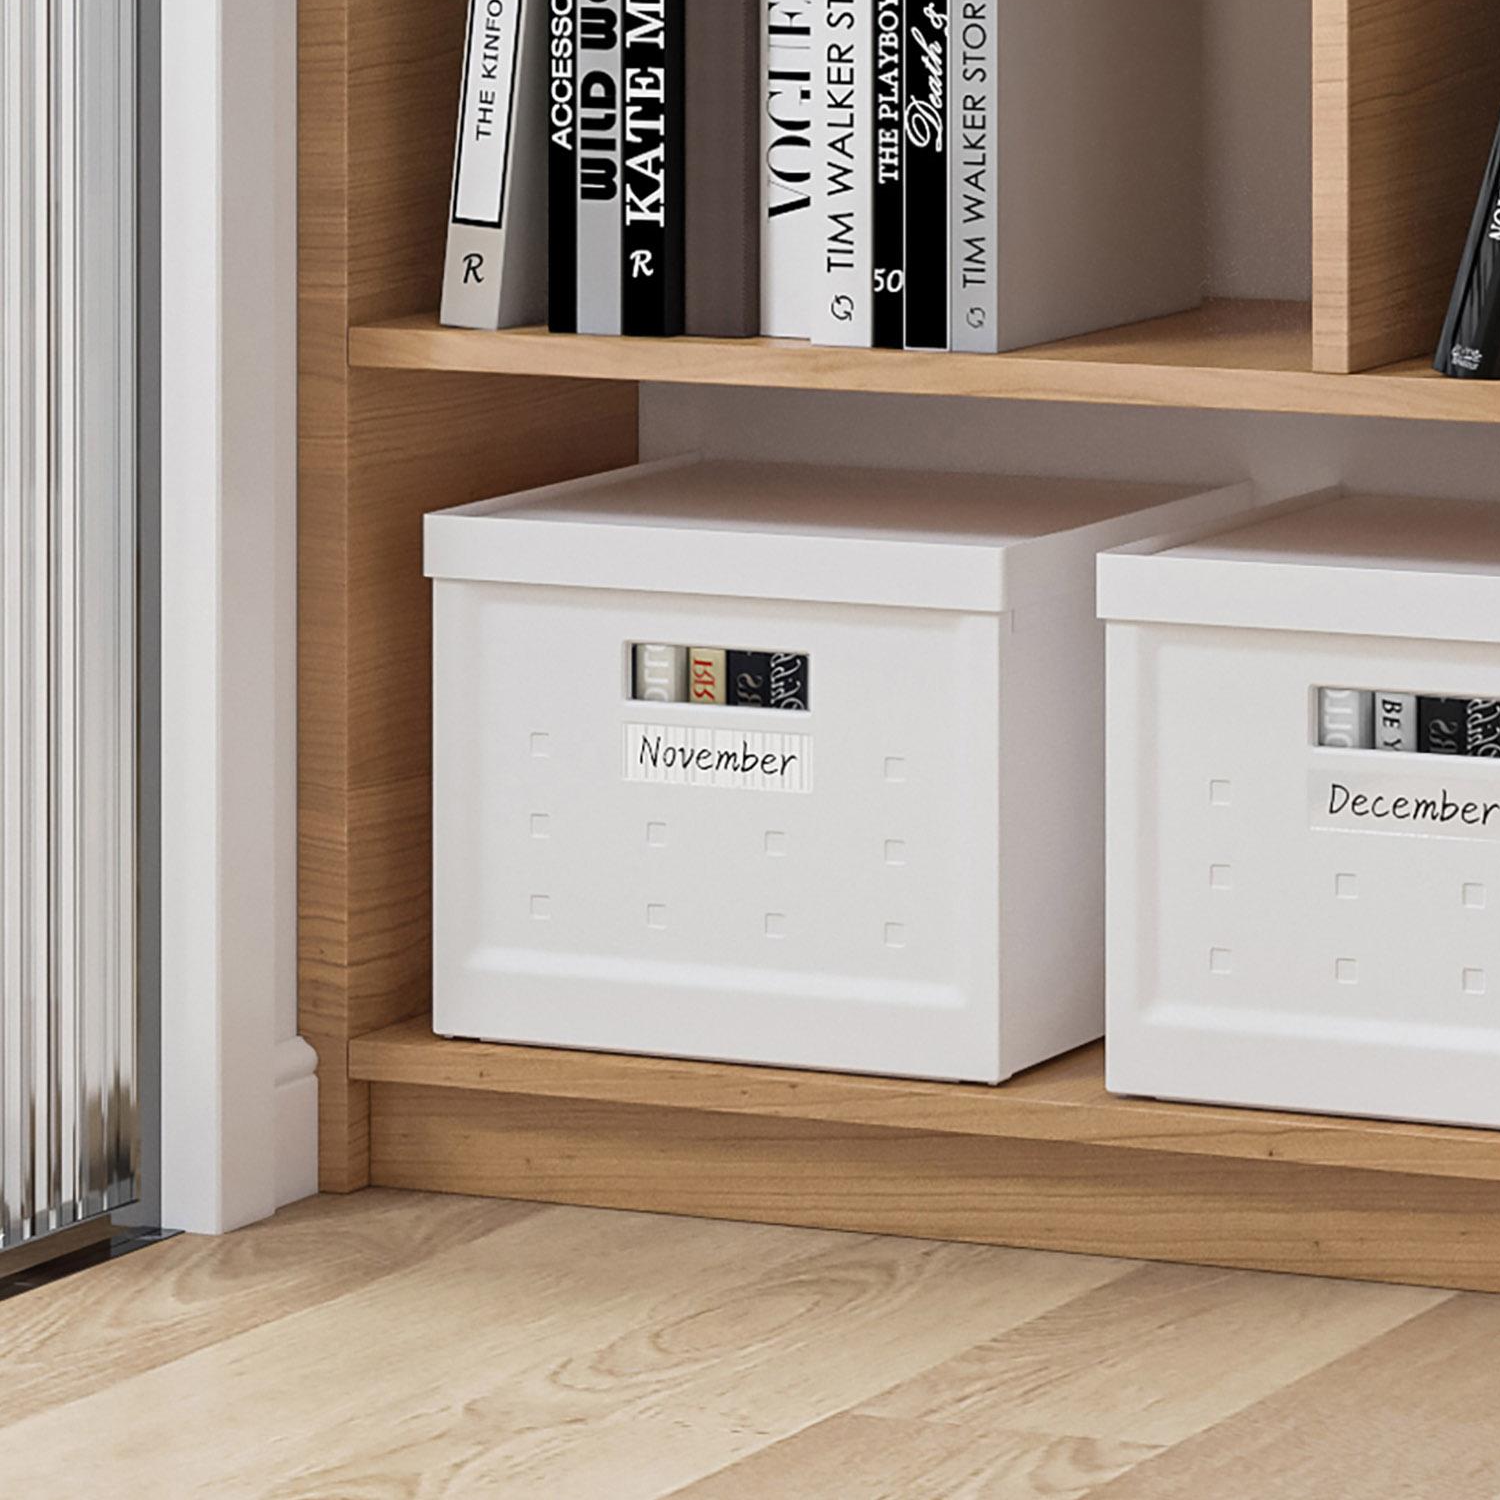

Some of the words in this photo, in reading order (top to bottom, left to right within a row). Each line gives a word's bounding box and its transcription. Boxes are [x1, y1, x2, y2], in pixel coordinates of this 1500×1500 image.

[476, 90, 495, 140] THE
[905, 26, 943, 152] Death
[580, 70, 617, 201] WILD
[827, 43, 854, 196] WALKER
[625, 67, 665, 227] KATE
[878, 128, 899, 184] THE
[963, 94, 986, 224] WALKER
[462, 253, 485, 284] R
[629, 249, 654, 278] R
[827, 212, 854, 273] TIM
[963, 237, 986, 288] TIM
[874, 268, 904, 293] 50
[639, 734, 798, 776] November
[1328, 783, 1500, 826] December
